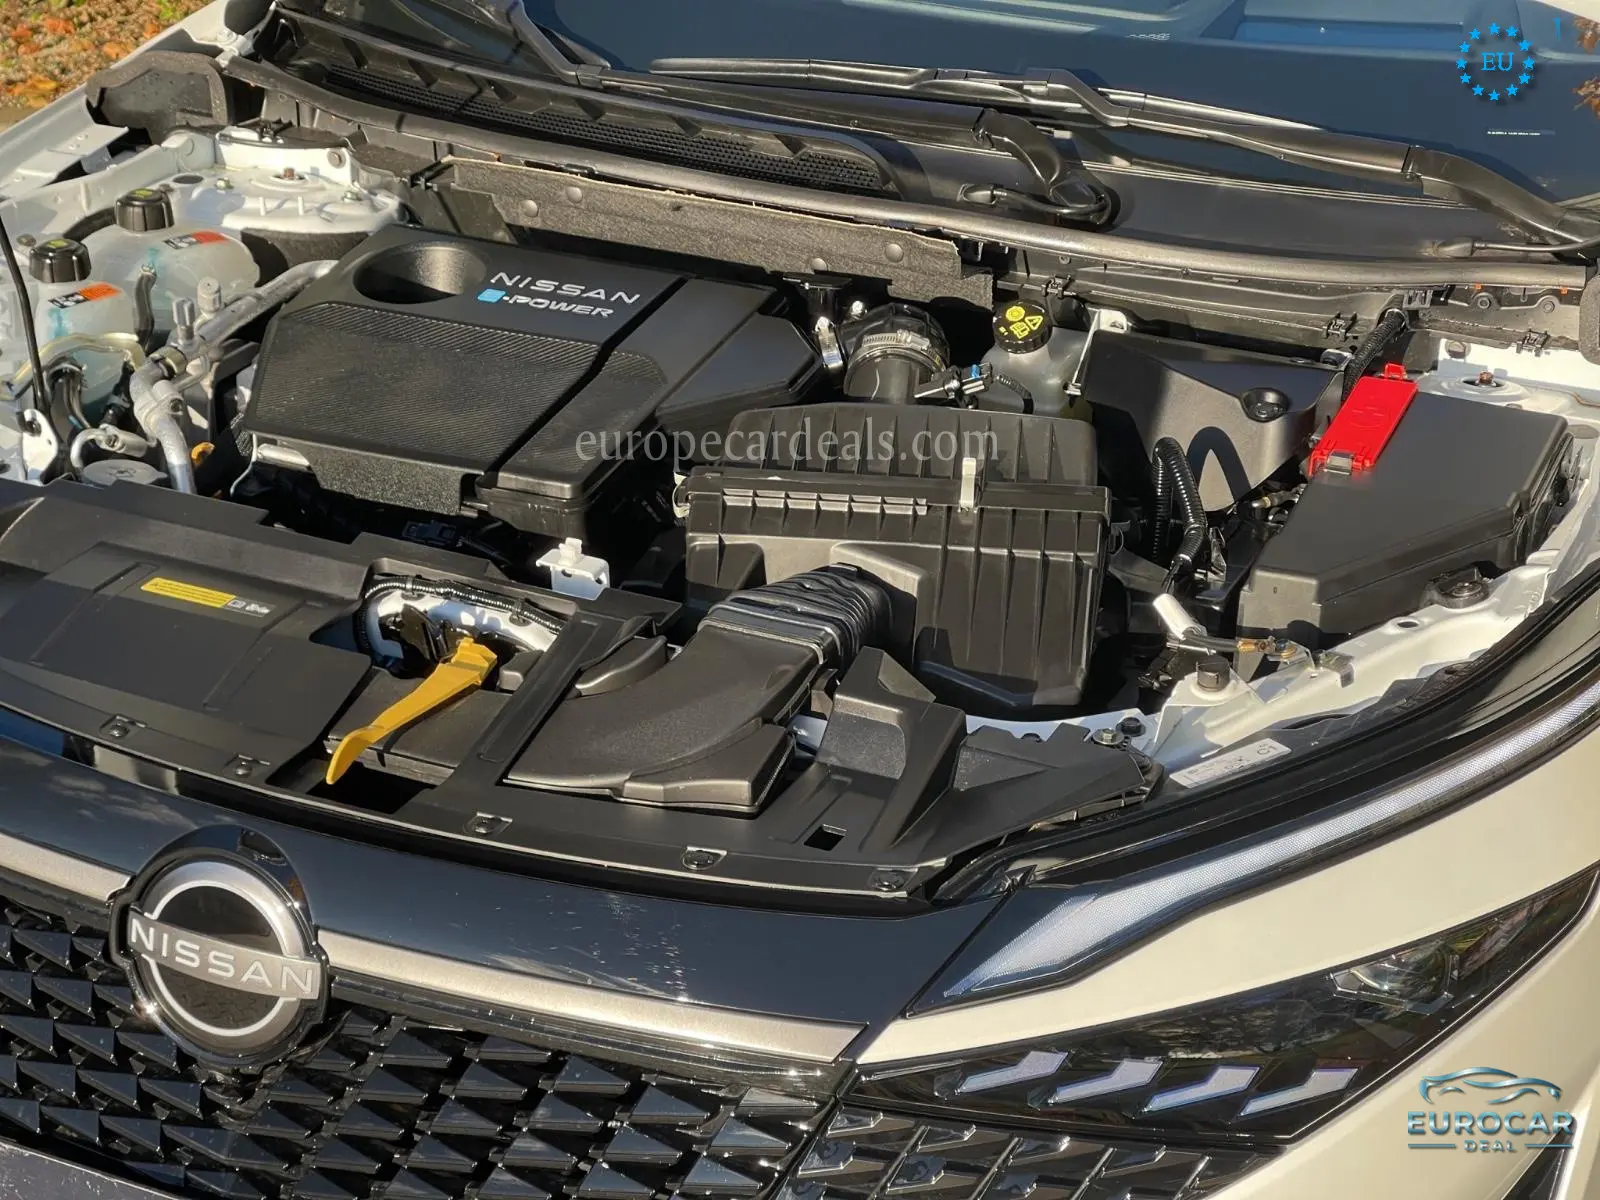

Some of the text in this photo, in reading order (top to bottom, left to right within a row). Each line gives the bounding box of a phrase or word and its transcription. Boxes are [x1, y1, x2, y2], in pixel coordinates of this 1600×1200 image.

[477, 288, 614, 318] -POWER
[490, 271, 641, 304] NISSAN
[130, 917, 314, 995] NISSAN
